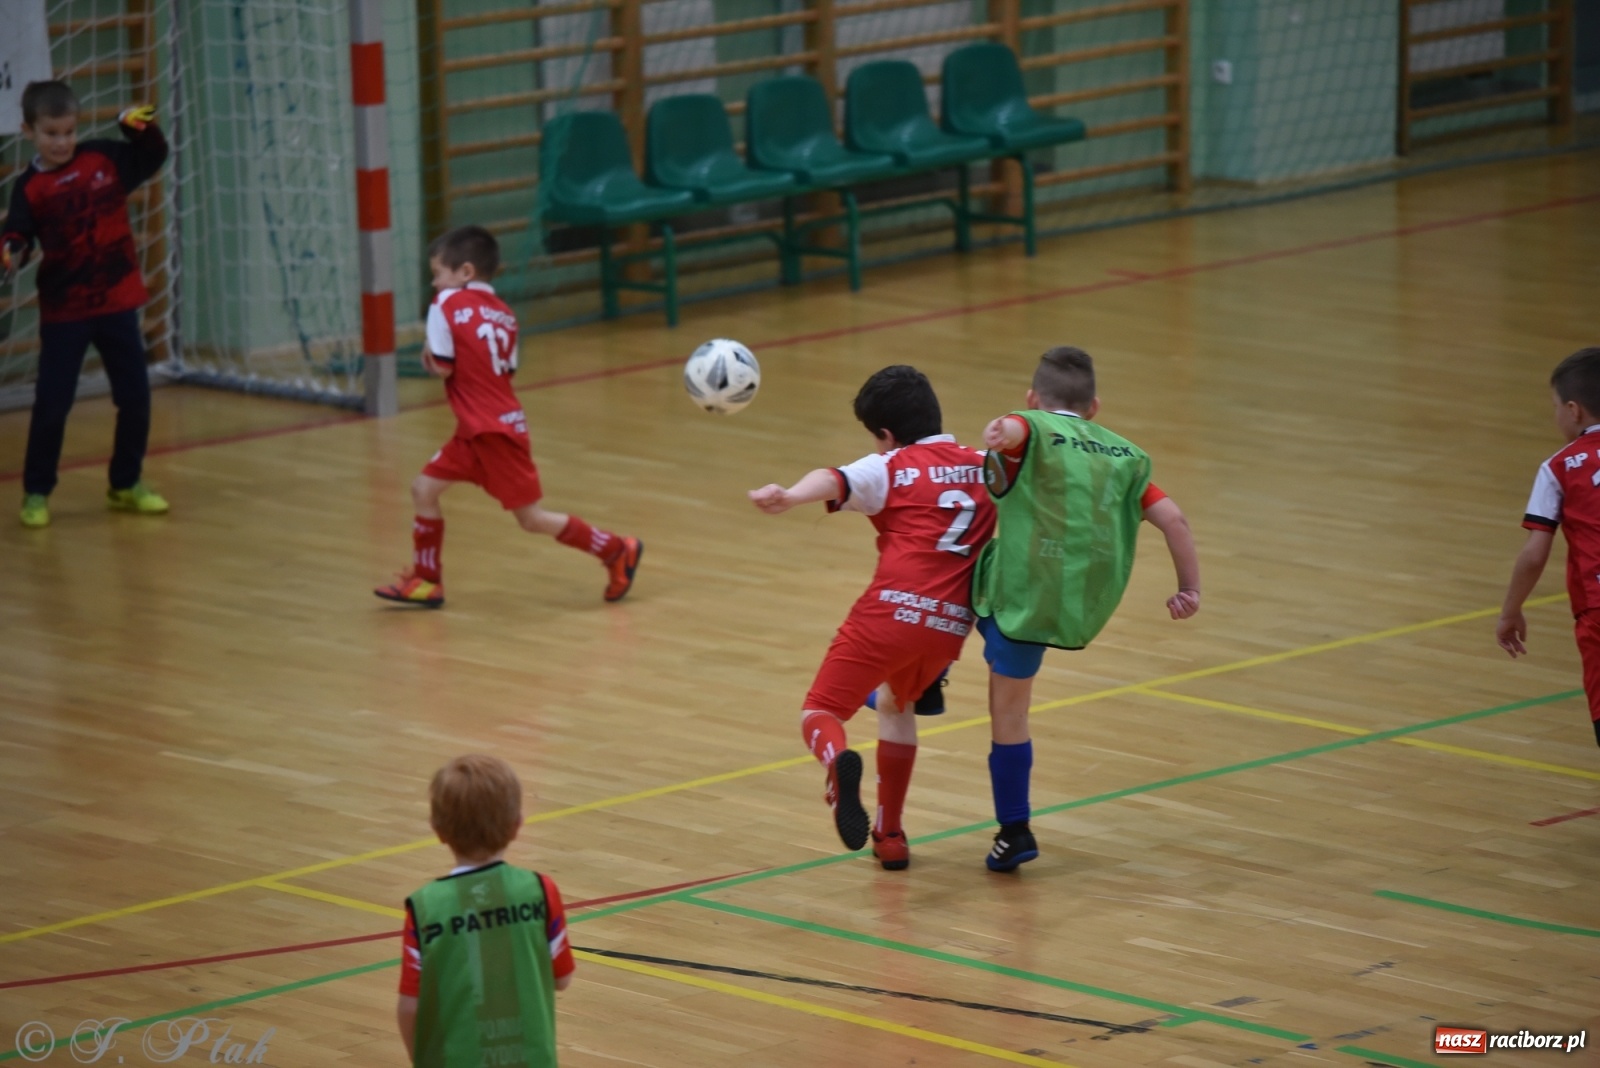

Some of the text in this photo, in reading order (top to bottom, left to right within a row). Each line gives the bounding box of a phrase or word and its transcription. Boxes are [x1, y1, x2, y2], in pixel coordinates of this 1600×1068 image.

[1564, 452, 1589, 472] AP
[893, 467, 921, 488] AP
[935, 489, 977, 557] 2
[450, 901, 547, 936] PATRICK
